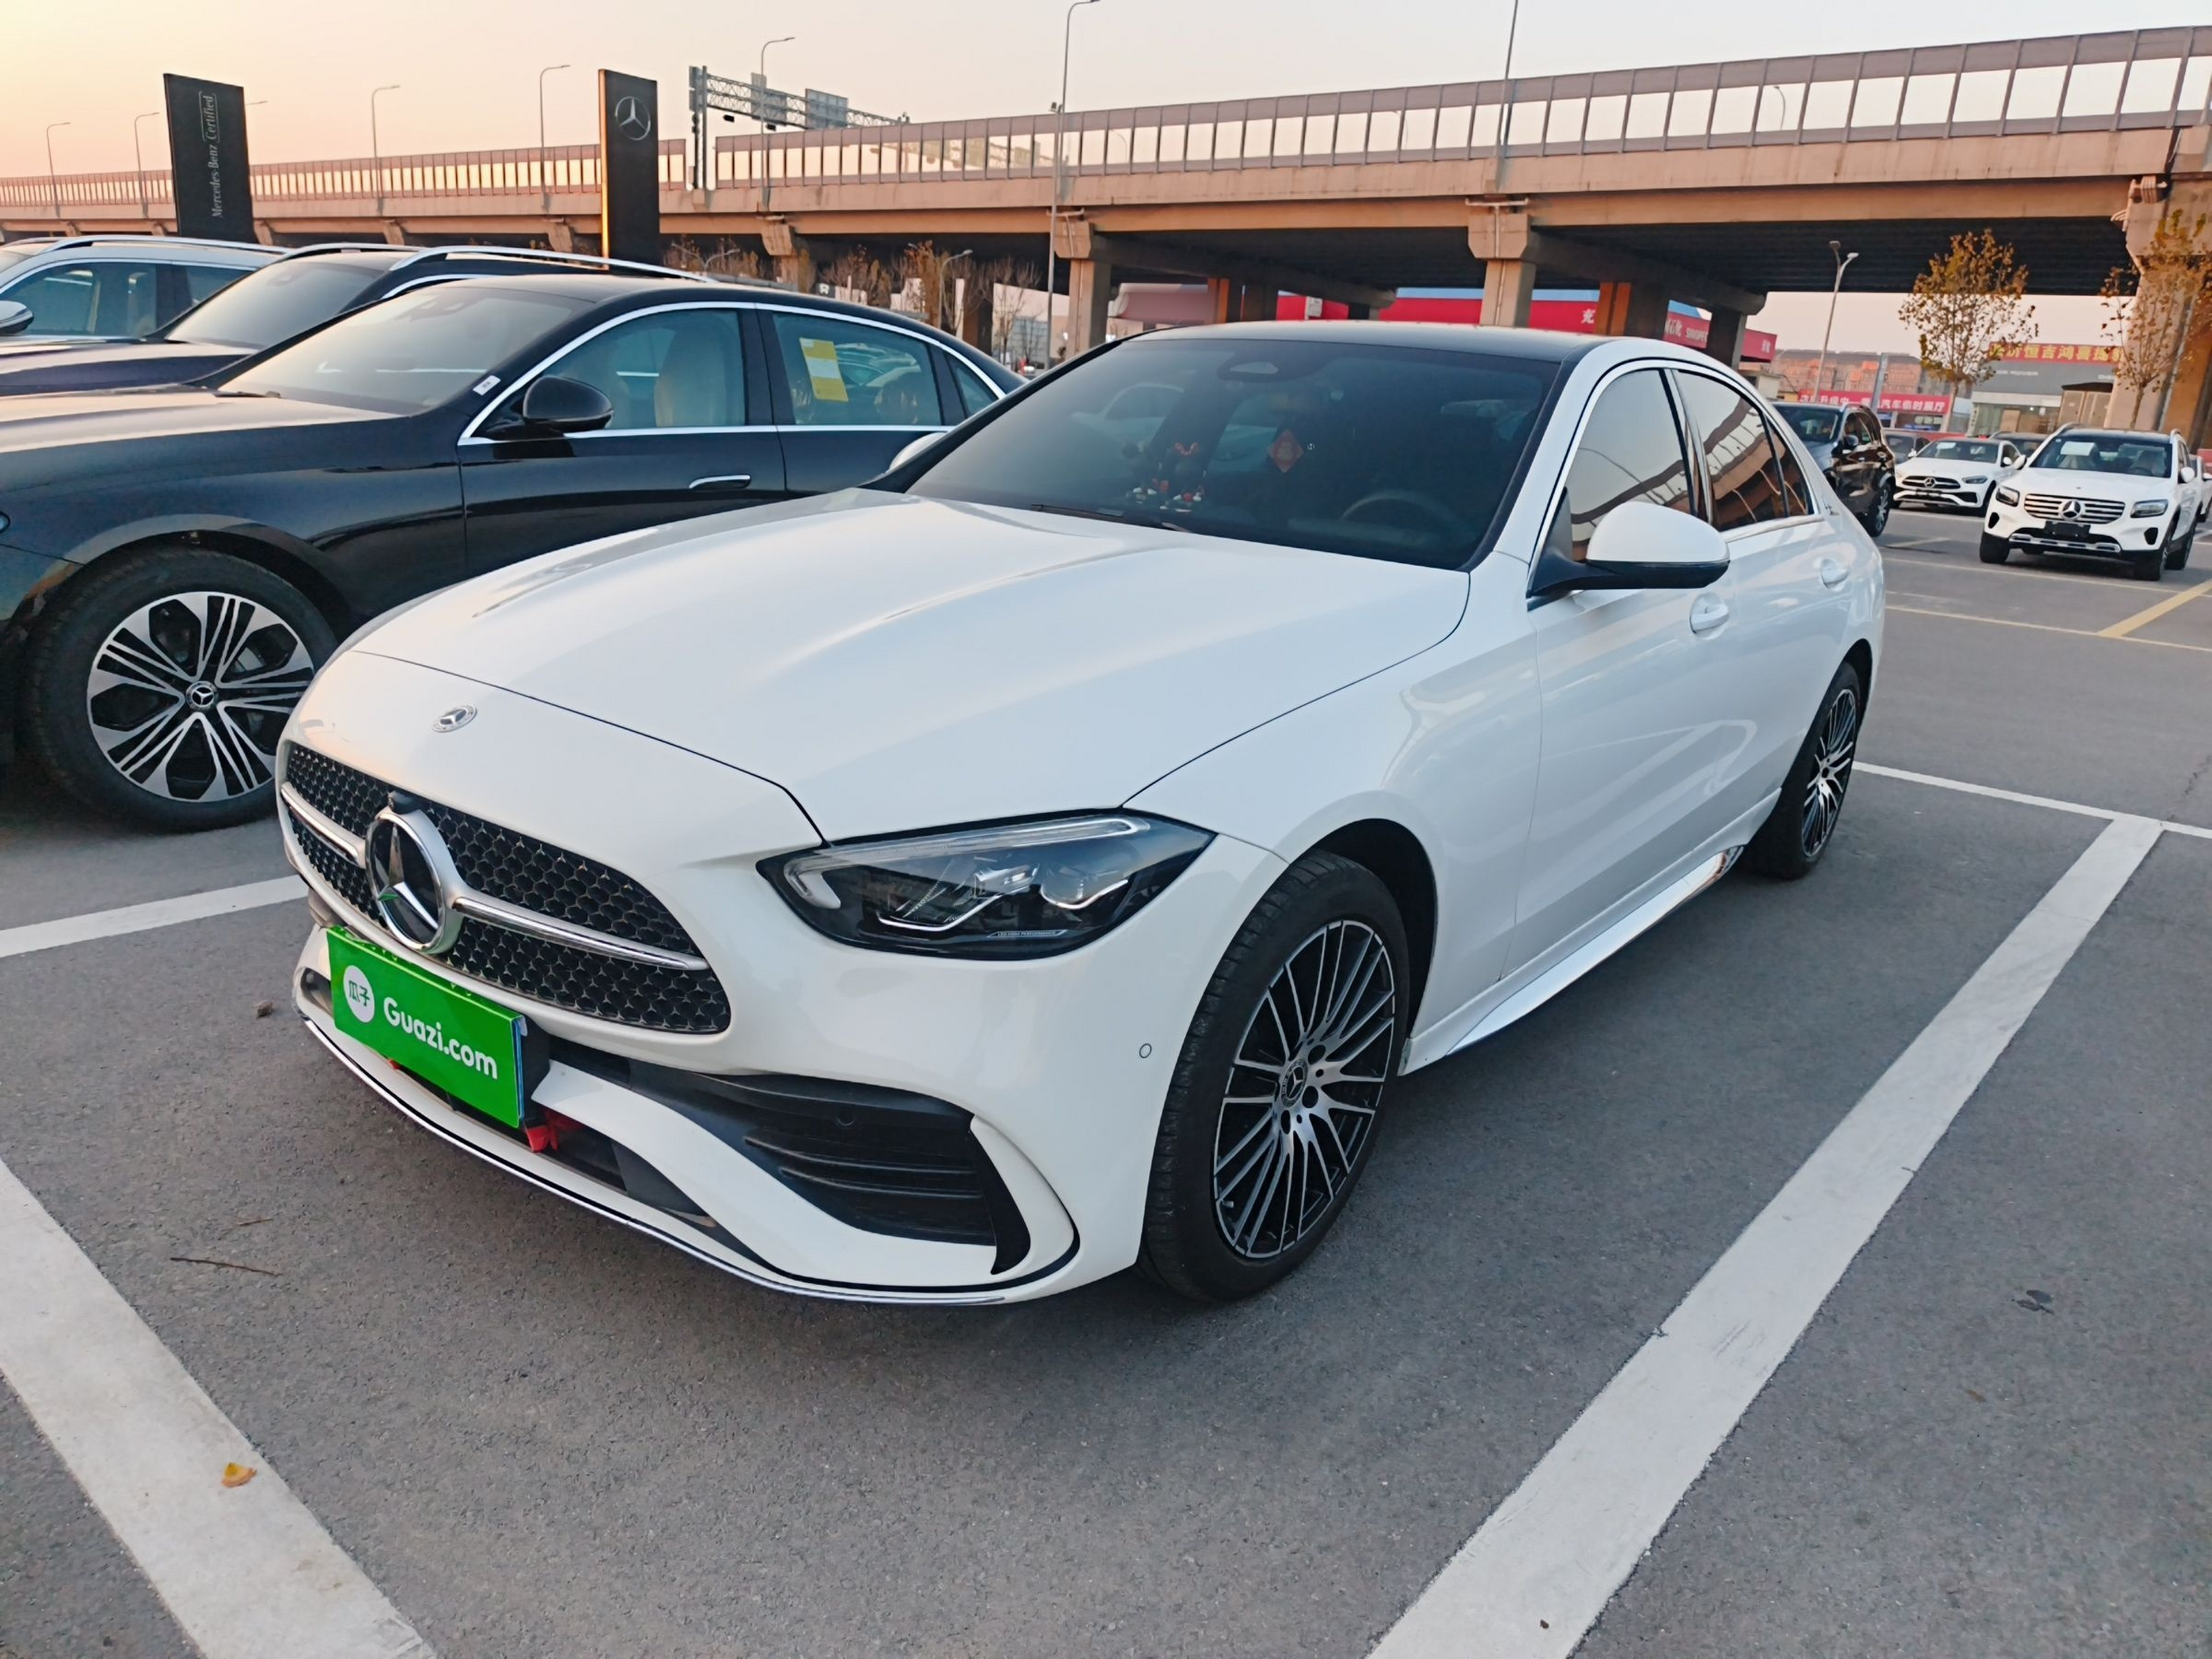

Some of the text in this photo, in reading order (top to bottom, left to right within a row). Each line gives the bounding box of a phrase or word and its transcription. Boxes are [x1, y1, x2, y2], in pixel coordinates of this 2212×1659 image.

[203, 95, 223, 218] Mercedes-Benz Certified
[349, 980, 370, 1006] 瓜子
[384, 997, 497, 1080] Guazi.com
